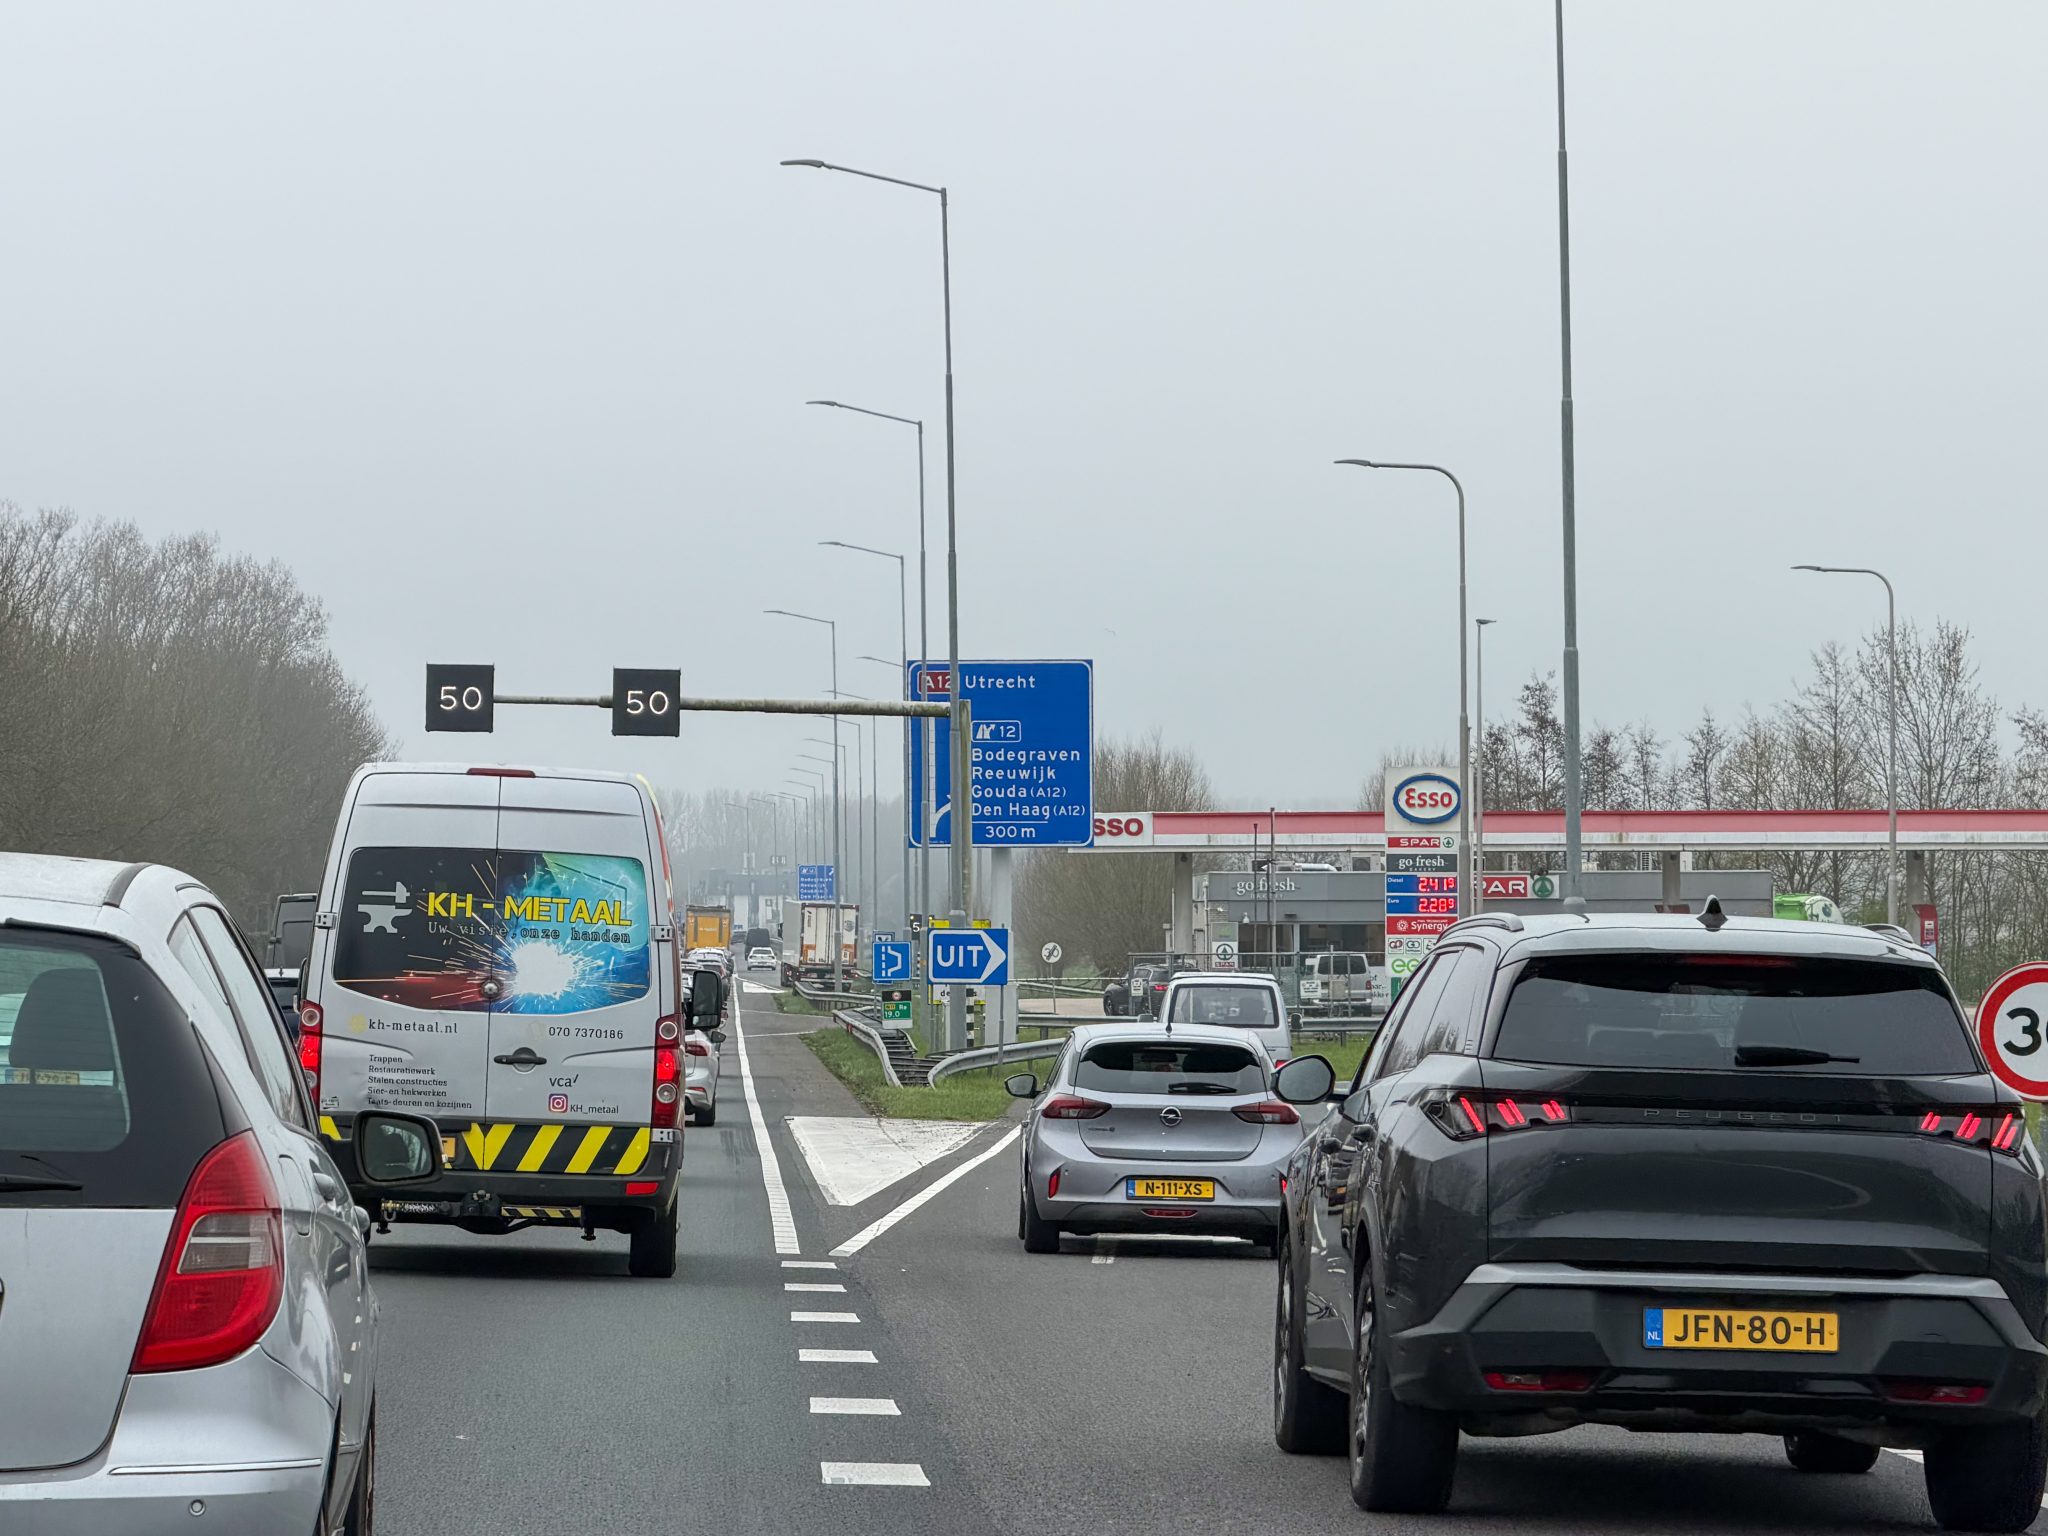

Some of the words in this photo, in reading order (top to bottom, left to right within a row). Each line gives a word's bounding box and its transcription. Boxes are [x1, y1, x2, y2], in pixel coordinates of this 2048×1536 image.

[965, 675, 1036, 689] Utrecht
[439, 686, 482, 711] 50
[626, 690, 669, 715] 50
[999, 725, 1016, 738] 12
[972, 748, 1081, 765] Bodegraven
[972, 766, 1056, 783] Reeuwijk
[972, 784, 1027, 798] Gouda
[1030, 786, 1066, 798] (A12)
[1405, 788, 1452, 808] Esso
[972, 803, 1002, 816] Den
[1009, 802, 1050, 820] Haag
[1053, 804, 1086, 816] (A12)
[985, 825, 1017, 838] 300
[1021, 827, 1036, 838] m
[1093, 818, 1143, 836] SSO
[1400, 838, 1440, 847] SPAR
[1398, 858, 1413, 870] go
[1416, 855, 1445, 867] fresh
[1236, 881, 1254, 896] go
[427, 892, 473, 918] KH
[504, 895, 633, 926] METAAL
[428, 921, 448, 934] Uw
[571, 928, 631, 944] handen
[1411, 921, 1448, 933] Synergy
[936, 945, 984, 968] UIT
[885, 1010, 900, 1018] 19.0
[368, 1019, 458, 1034] kh-metaal.nl
[549, 1026, 570, 1037] 070
[575, 1027, 624, 1040] 7370186
[2003, 1007, 2048, 1057] 3
[369, 1054, 403, 1064] Trappen
[368, 1076, 394, 1085] Stalen
[395, 1078, 448, 1087] constructies
[549, 1077, 573, 1087] vca
[570, 1104, 619, 1114] KH_metaal
[1643, 1108, 1841, 1123] PEUGEOT
[1145, 1182, 1203, 1197] N-111-XS
[1647, 1331, 1661, 1342] NL
[1674, 1314, 1825, 1346] JFN-80-H
